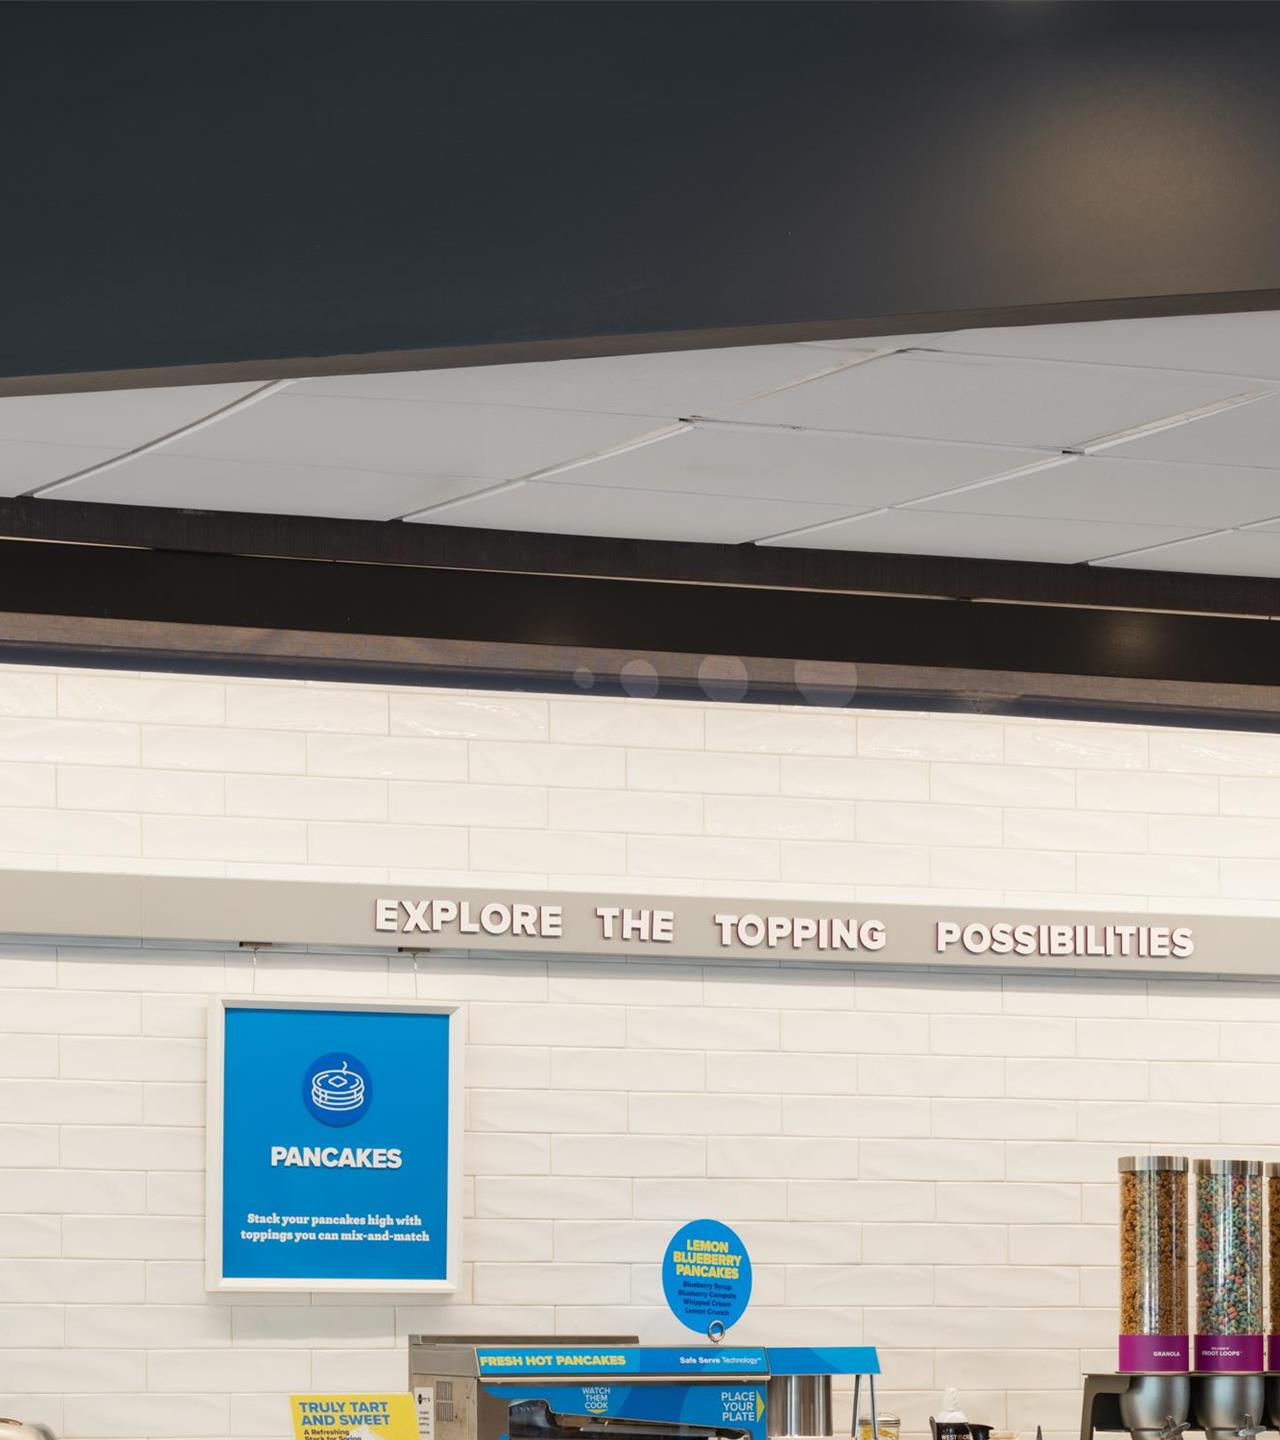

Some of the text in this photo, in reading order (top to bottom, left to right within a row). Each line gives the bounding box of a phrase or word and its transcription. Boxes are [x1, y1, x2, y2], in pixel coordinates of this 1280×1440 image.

[375, 898, 1195, 958] EXPLORE THE TOPPING POSSIBILITIES
[270, 1146, 403, 1169] PANCAKES
[247, 1213, 422, 1228] Stack your pancakes high with
[240, 1228, 430, 1242] toppings you can mix-and-match
[686, 1239, 728, 1253] LEMON
[672, 1251, 742, 1267] BLUEBERRY
[676, 1263, 739, 1280] PANCAKES
[479, 1355, 627, 1367] FRESH HOT PANCAKES
[679, 1356, 697, 1364] Safe
[698, 1356, 721, 1364] Serve
[581, 1387, 611, 1395] WATCH
[721, 1391, 755, 1401] PLACE
[584, 1394, 608, 1402] THEM
[298, 1401, 389, 1413] TRULY TART
[723, 1402, 753, 1412] YOUR
[301, 1414, 391, 1426] AND SWEET
[722, 1412, 755, 1422] PLATE
[303, 1428, 350, 1437] A Refreshing
